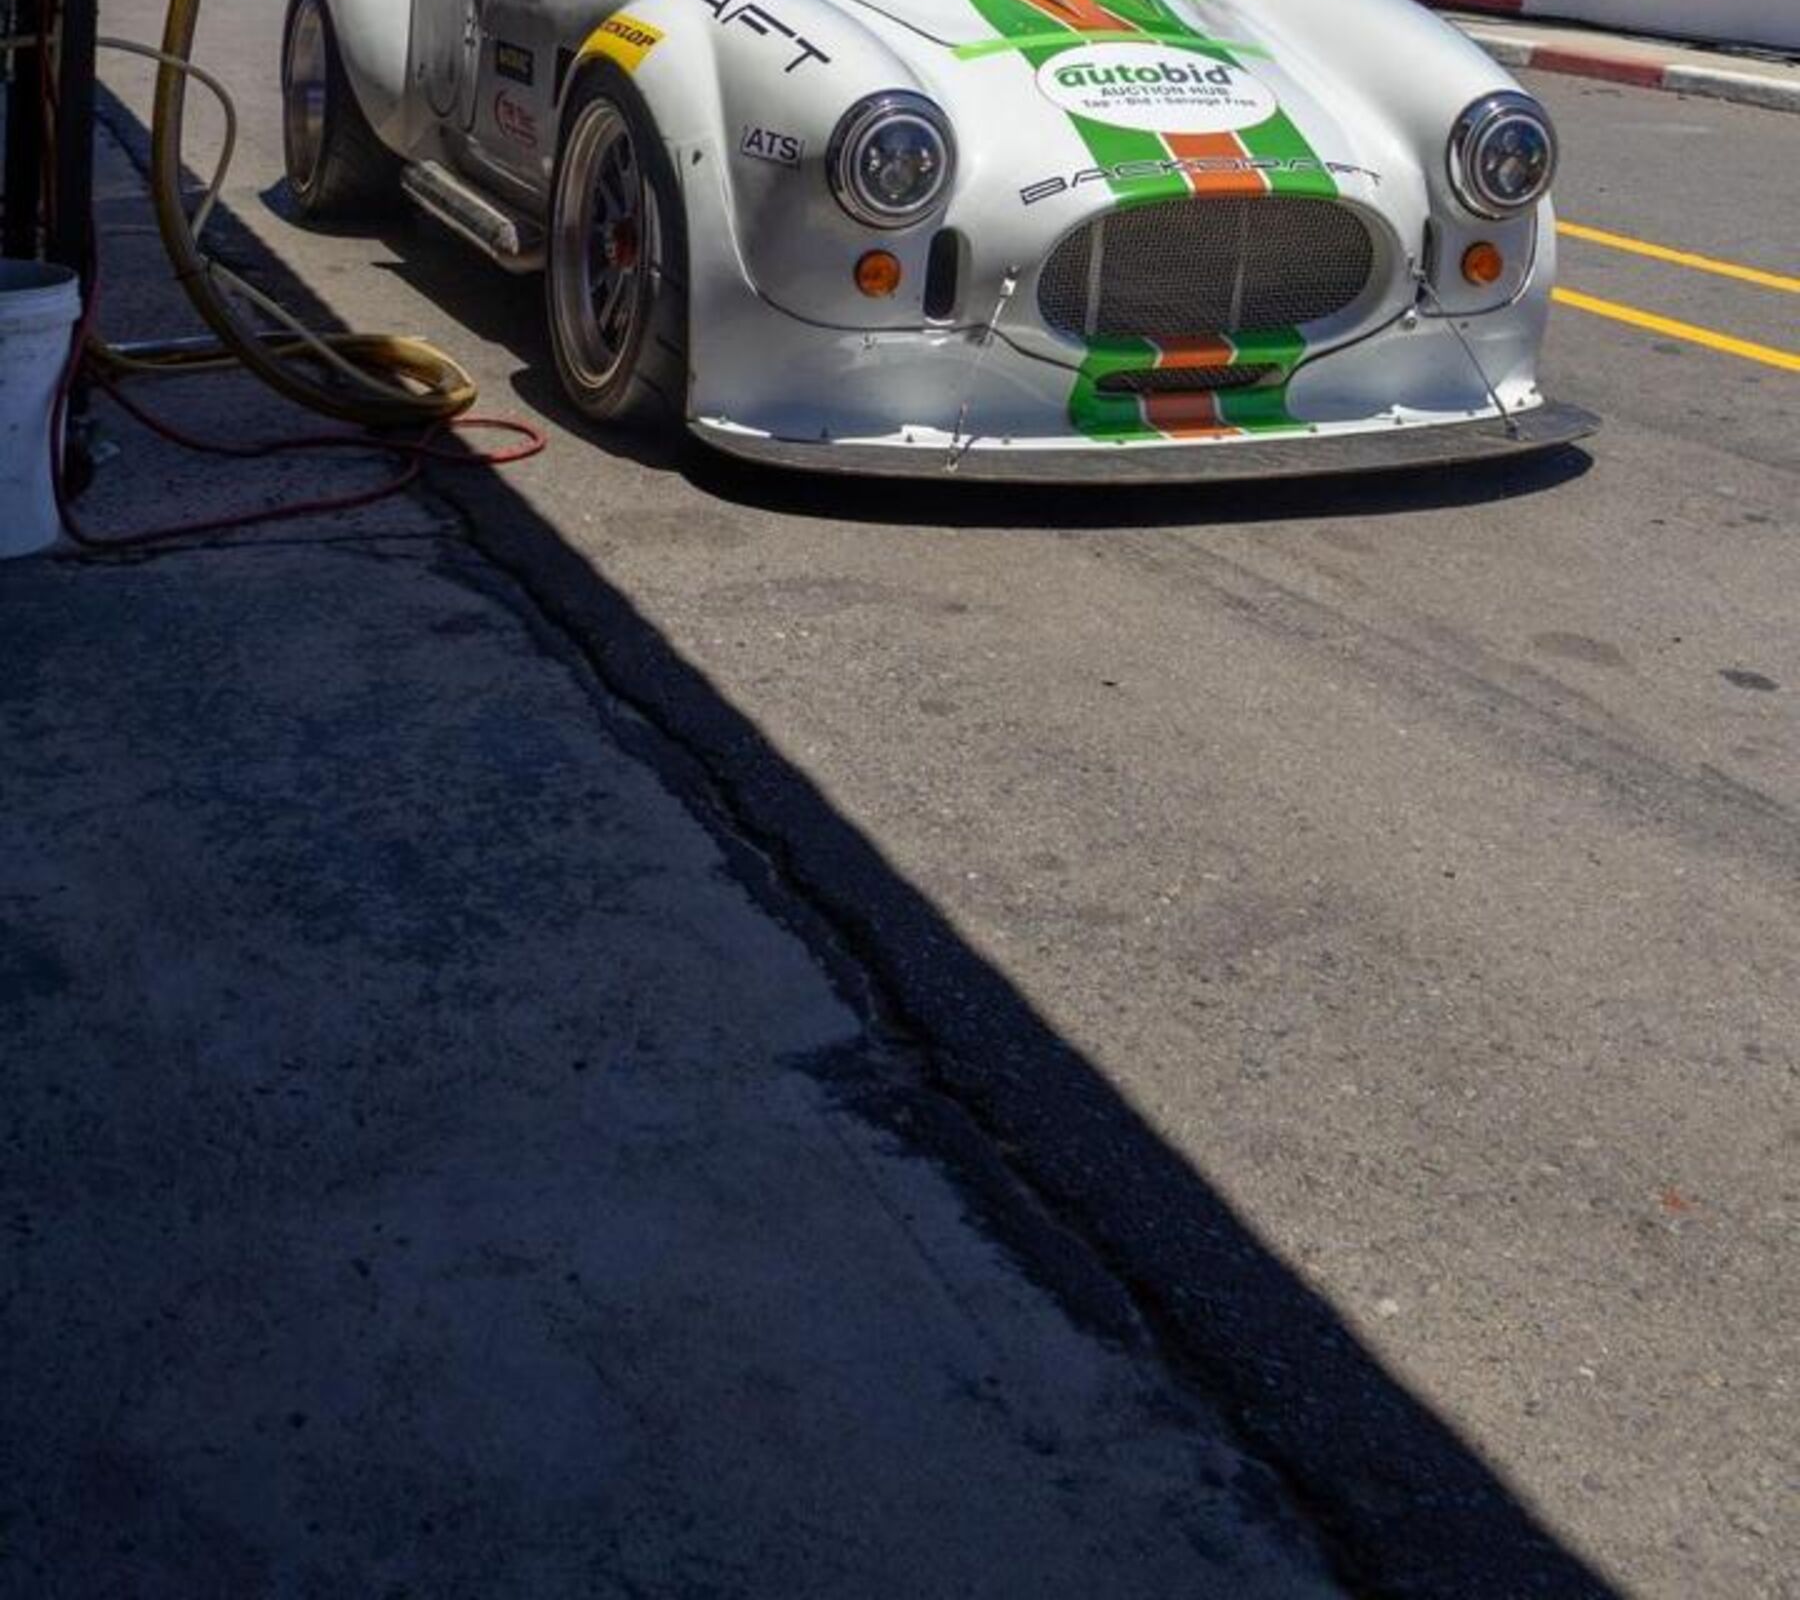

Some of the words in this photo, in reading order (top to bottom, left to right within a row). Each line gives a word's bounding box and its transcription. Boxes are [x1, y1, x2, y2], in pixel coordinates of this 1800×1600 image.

[1055, 62, 1233, 86] autobid
[1101, 86, 1185, 97] AUCTION
[1189, 86, 1229, 96] HUB
[745, 127, 799, 161] ATS
